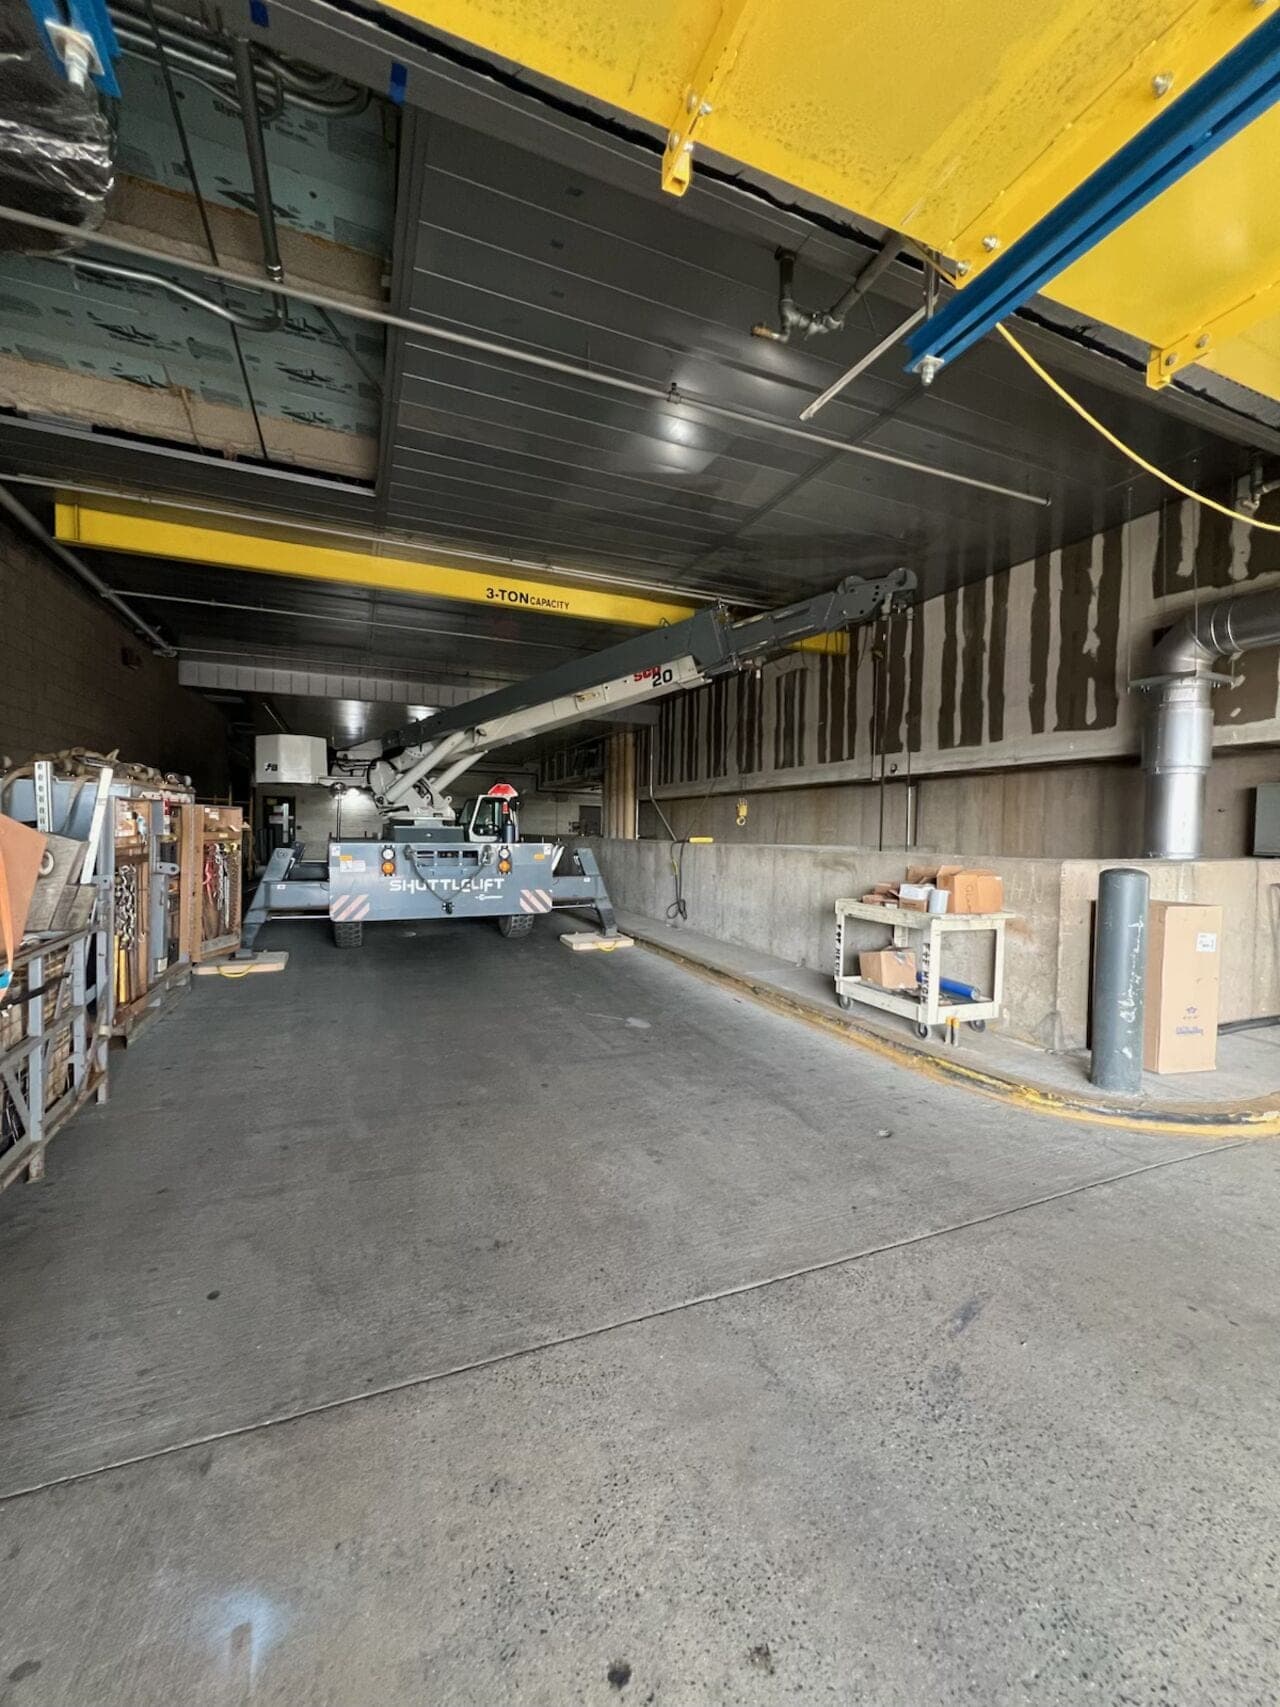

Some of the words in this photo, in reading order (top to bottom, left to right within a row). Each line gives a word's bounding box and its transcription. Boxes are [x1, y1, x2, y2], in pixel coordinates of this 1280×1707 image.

[486, 587, 529, 604] 3-TON
[530, 596, 570, 610] CAPACITY
[652, 669, 673, 687] 20
[389, 878, 505, 895] SHUTTLELIFT
